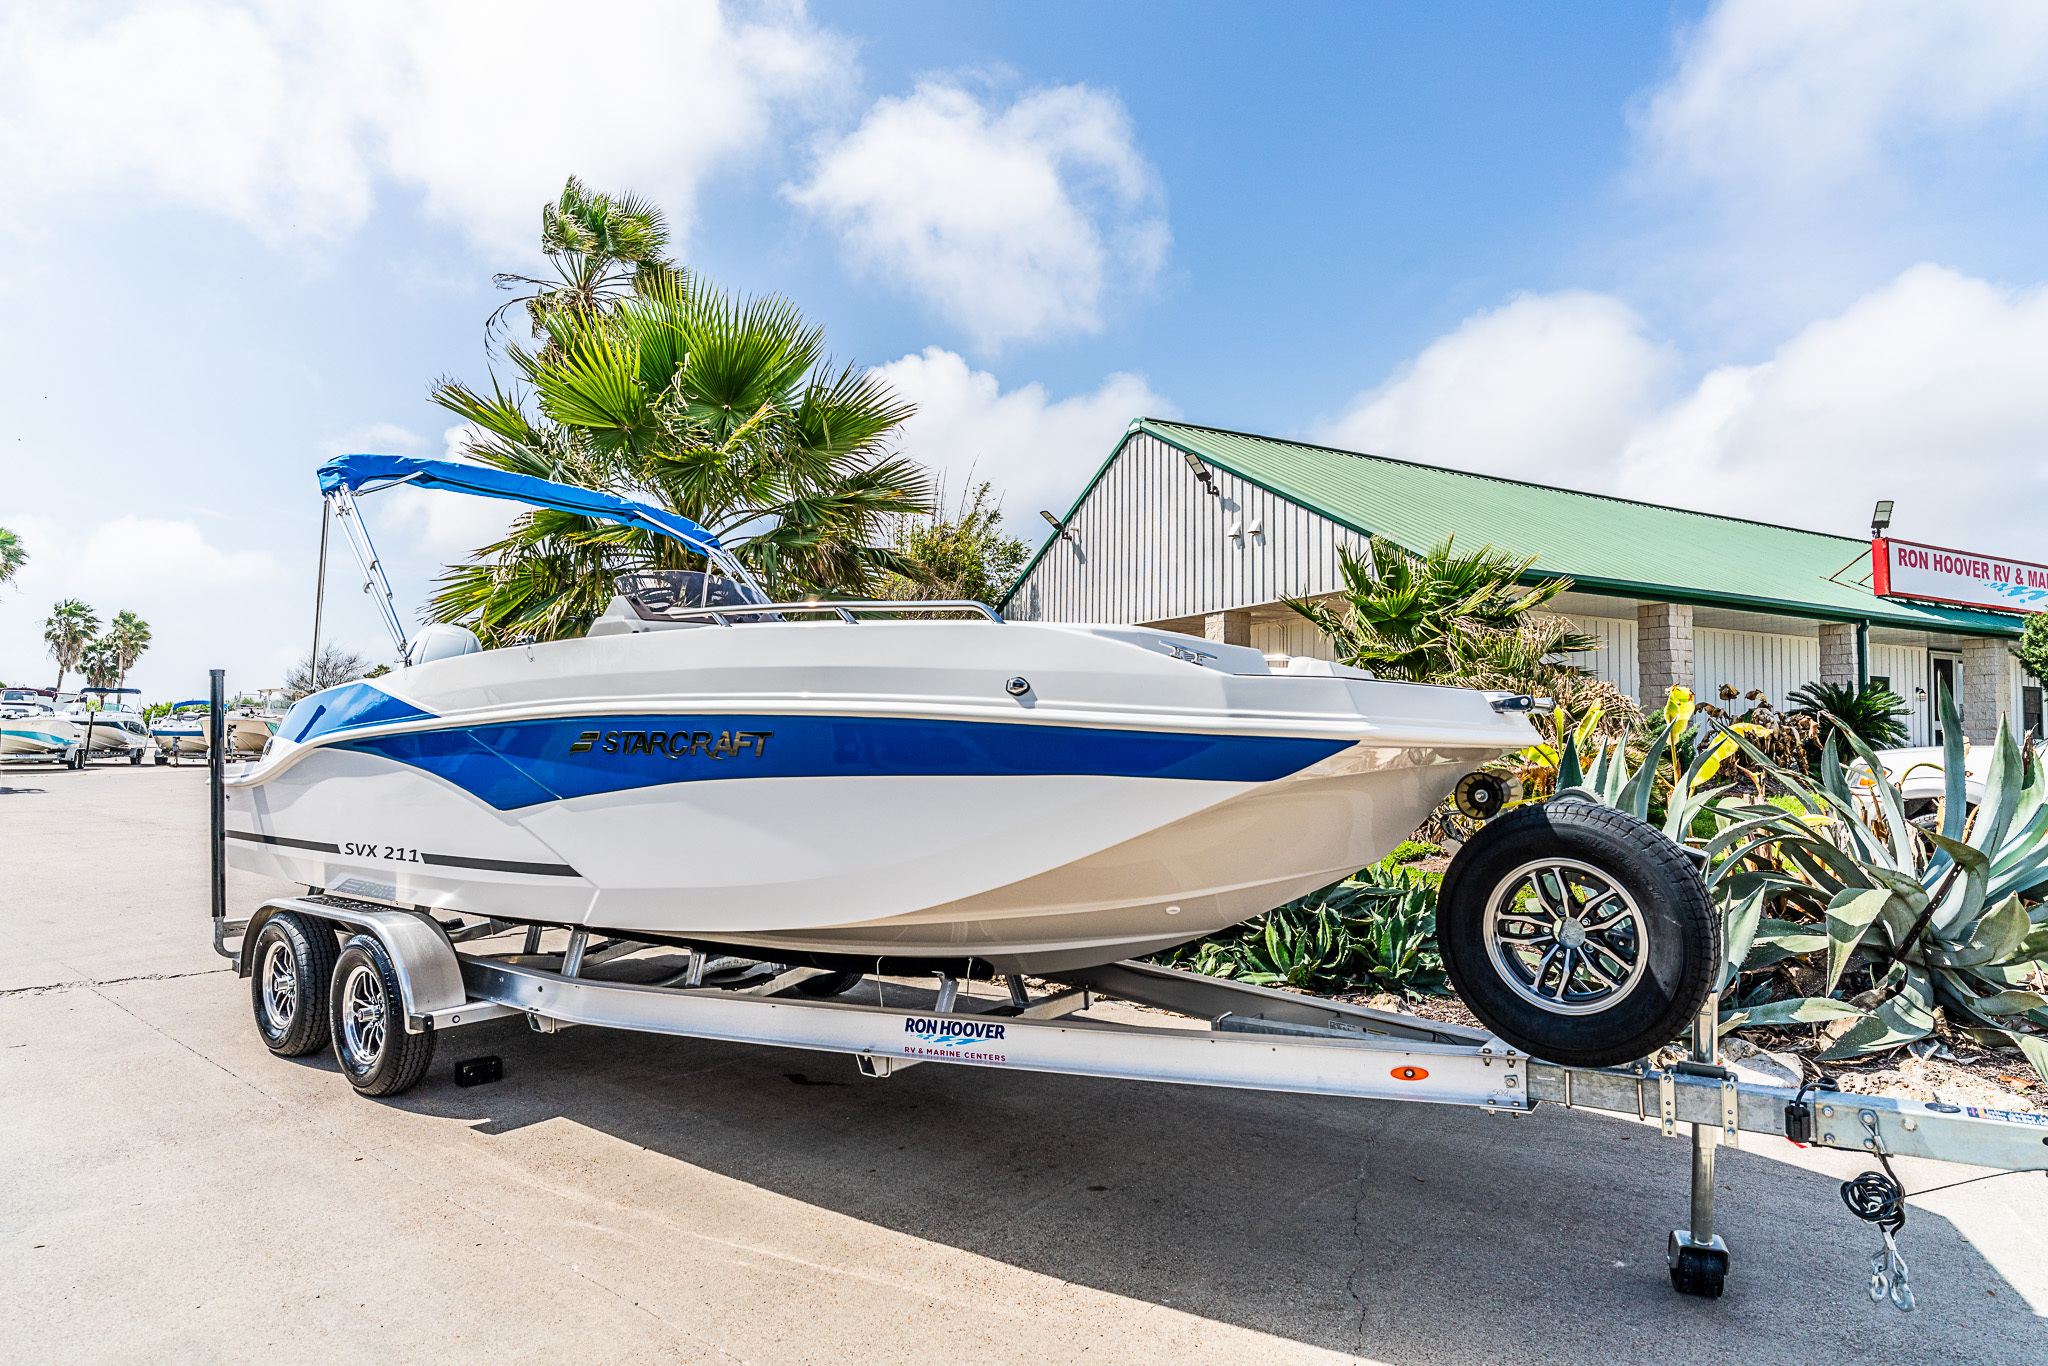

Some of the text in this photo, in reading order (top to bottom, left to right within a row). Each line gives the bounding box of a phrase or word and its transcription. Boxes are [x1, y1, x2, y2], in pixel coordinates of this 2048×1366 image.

[1897, 547, 1929, 570] RON
[1933, 553, 1990, 580] HOOVER
[1993, 564, 2011, 583] RV
[2014, 568, 2024, 586] &
[602, 730, 775, 760] STARCRAFT
[343, 842, 420, 863] SVX 211
[904, 1017, 1006, 1040] RON HOOVER
[926, 1048, 961, 1058] MARINE
[964, 1051, 1006, 1062] CENTERS
